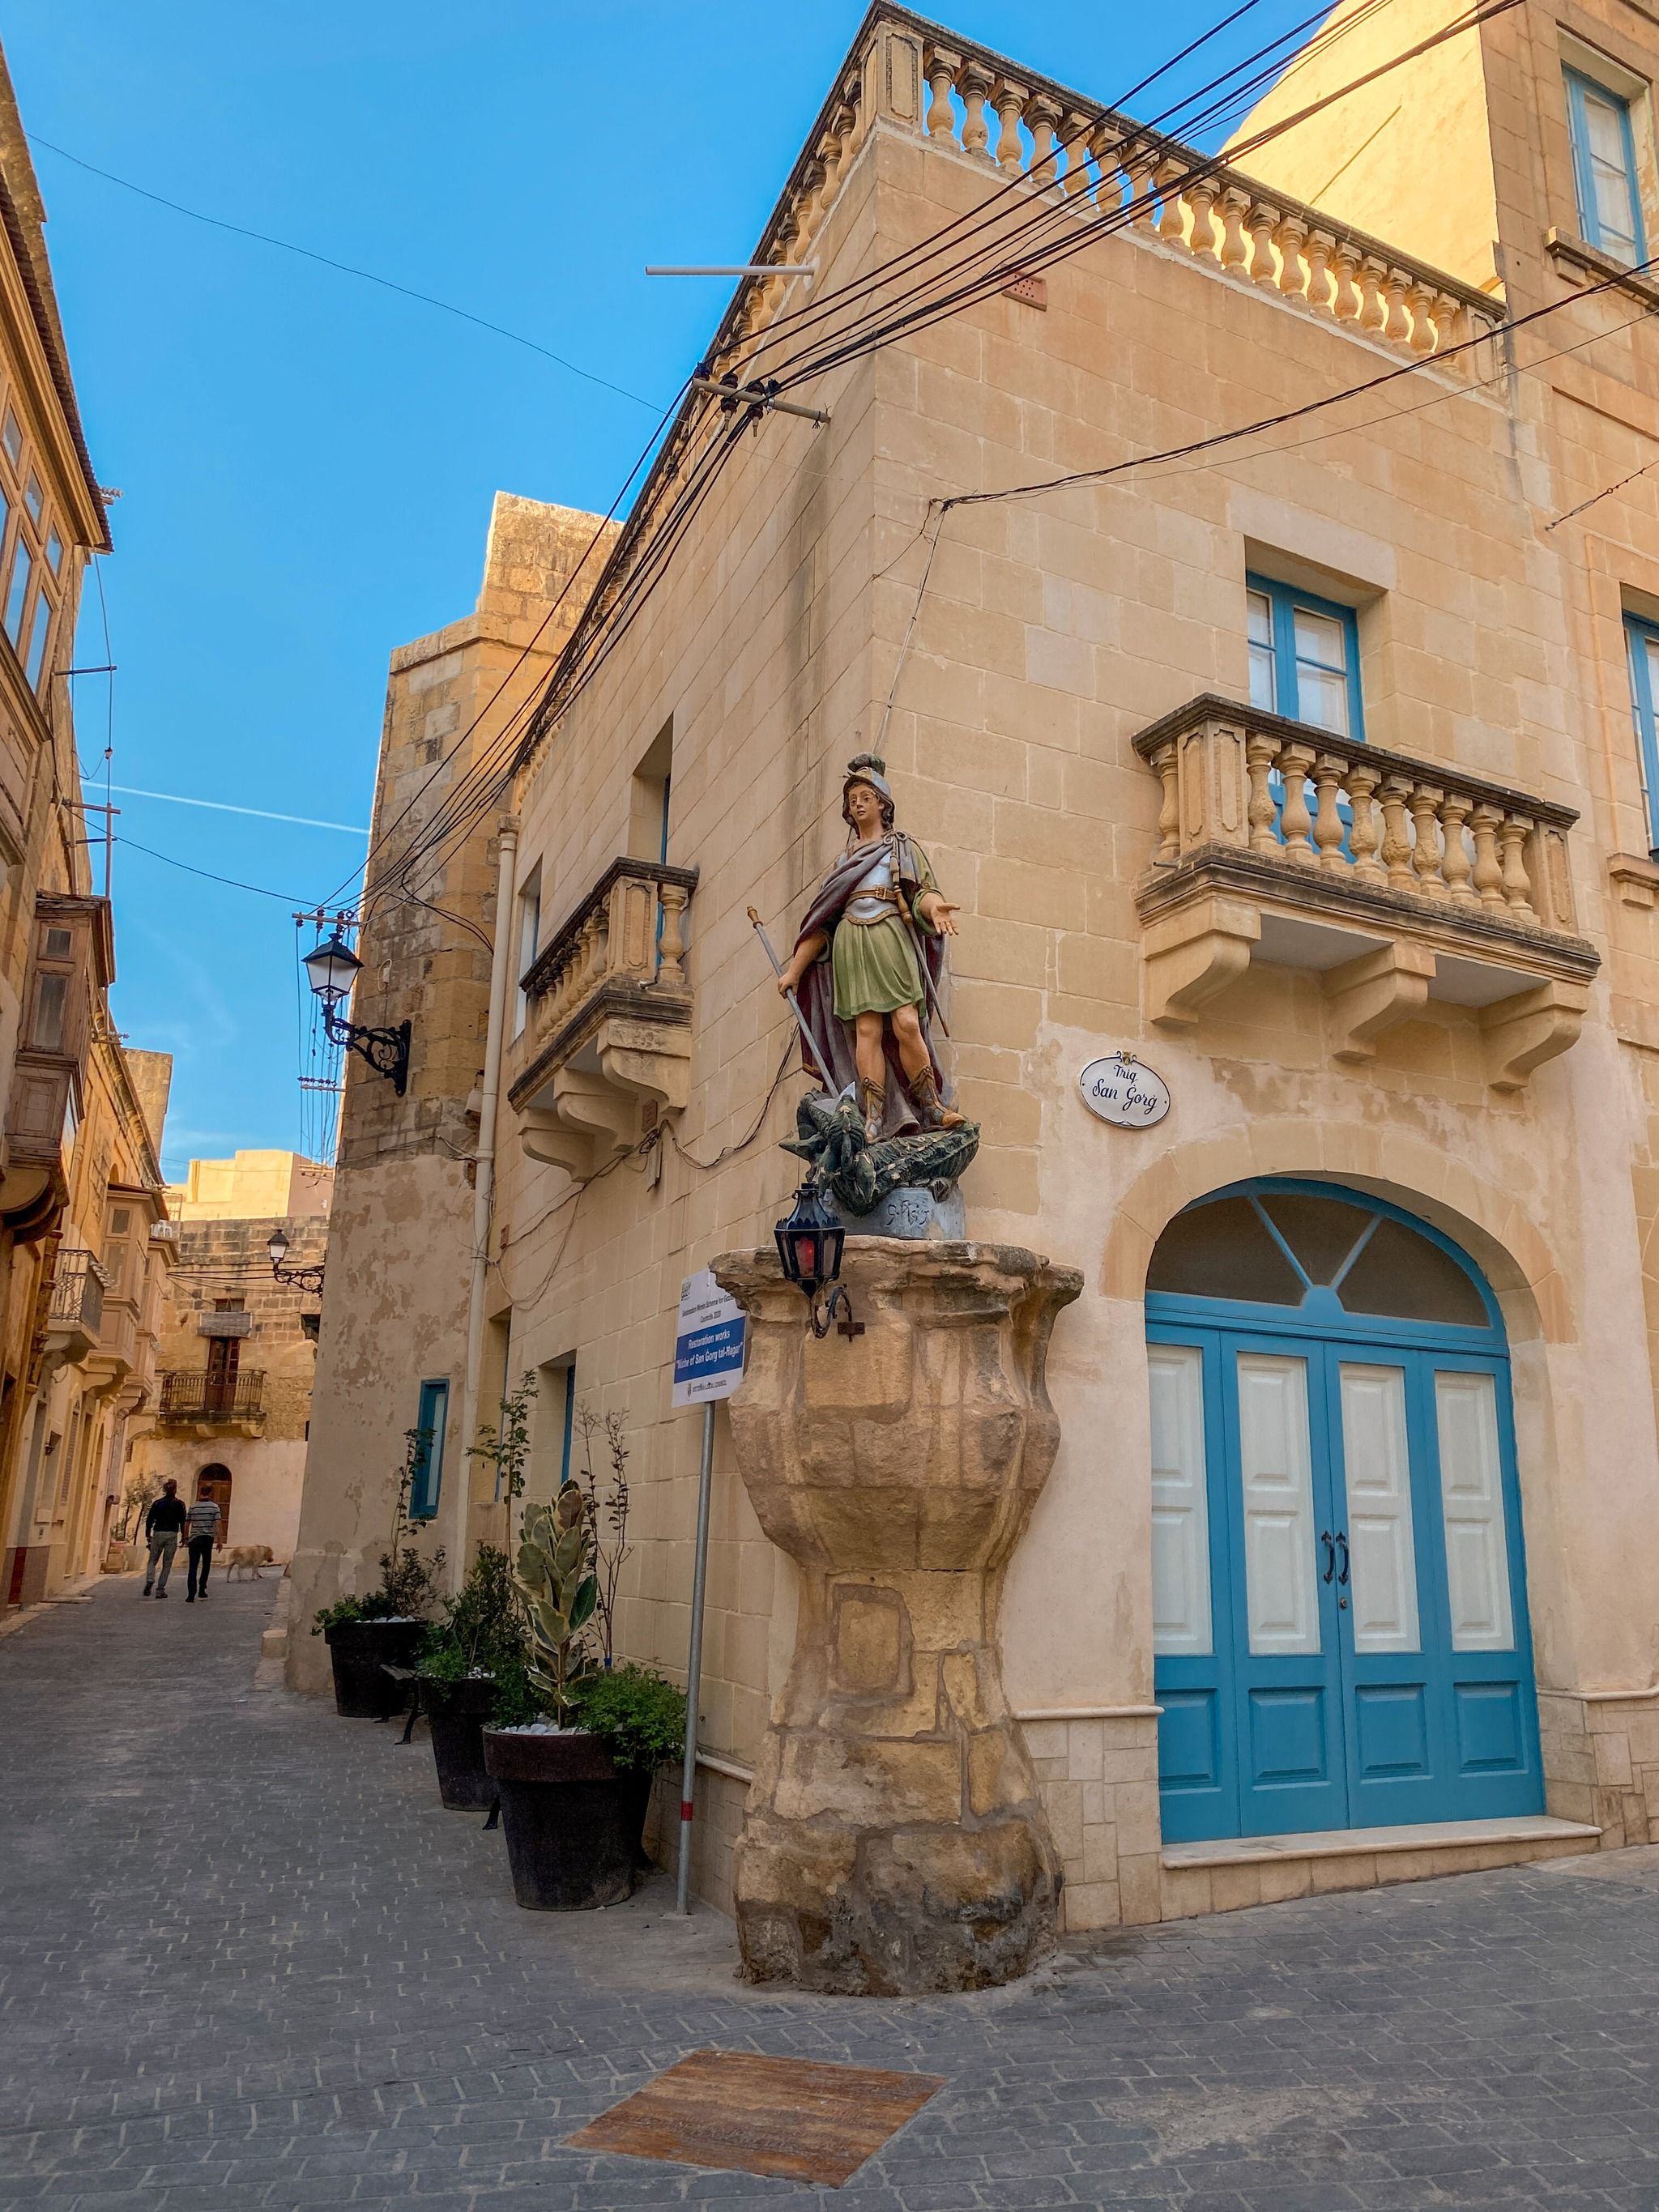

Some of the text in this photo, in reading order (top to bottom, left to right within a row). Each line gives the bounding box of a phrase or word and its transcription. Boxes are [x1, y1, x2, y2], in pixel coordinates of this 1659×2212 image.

[1113, 1064, 1138, 1084] Triq
[1092, 1078, 1158, 1115] San Ġorġ
[688, 1329, 731, 1349] Restoration works
[695, 1353, 705, 1365] San
